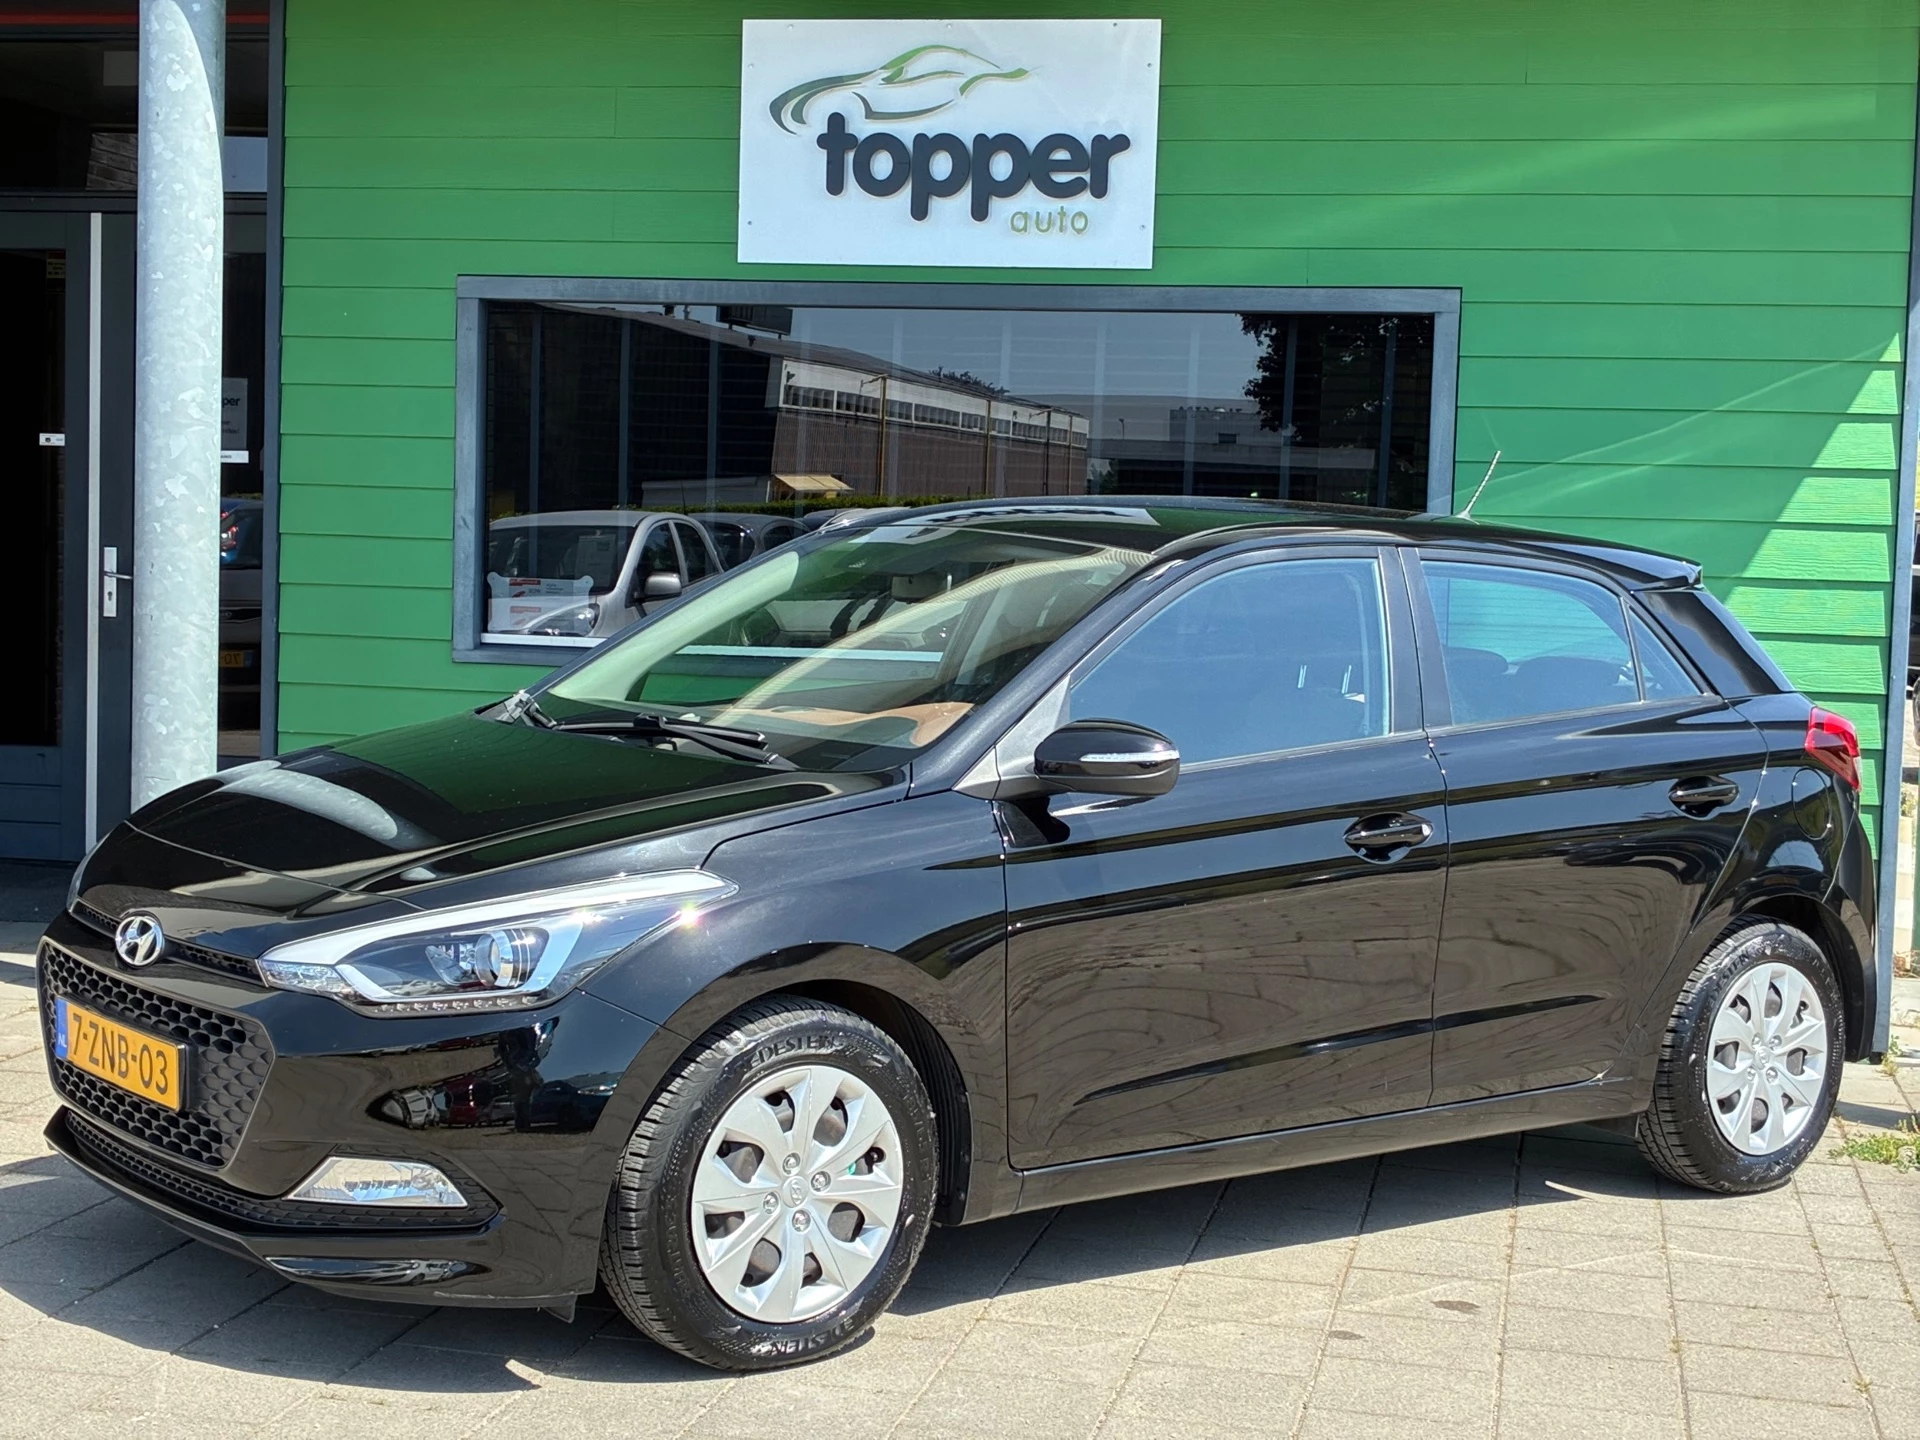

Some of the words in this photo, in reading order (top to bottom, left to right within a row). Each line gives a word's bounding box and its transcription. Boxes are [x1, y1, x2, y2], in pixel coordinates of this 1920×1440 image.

[816, 112, 1131, 222] topper
[1010, 206, 1089, 234] auto
[58, 1032, 67, 1048] NL
[72, 1013, 168, 1095] 7-ZNB-03
